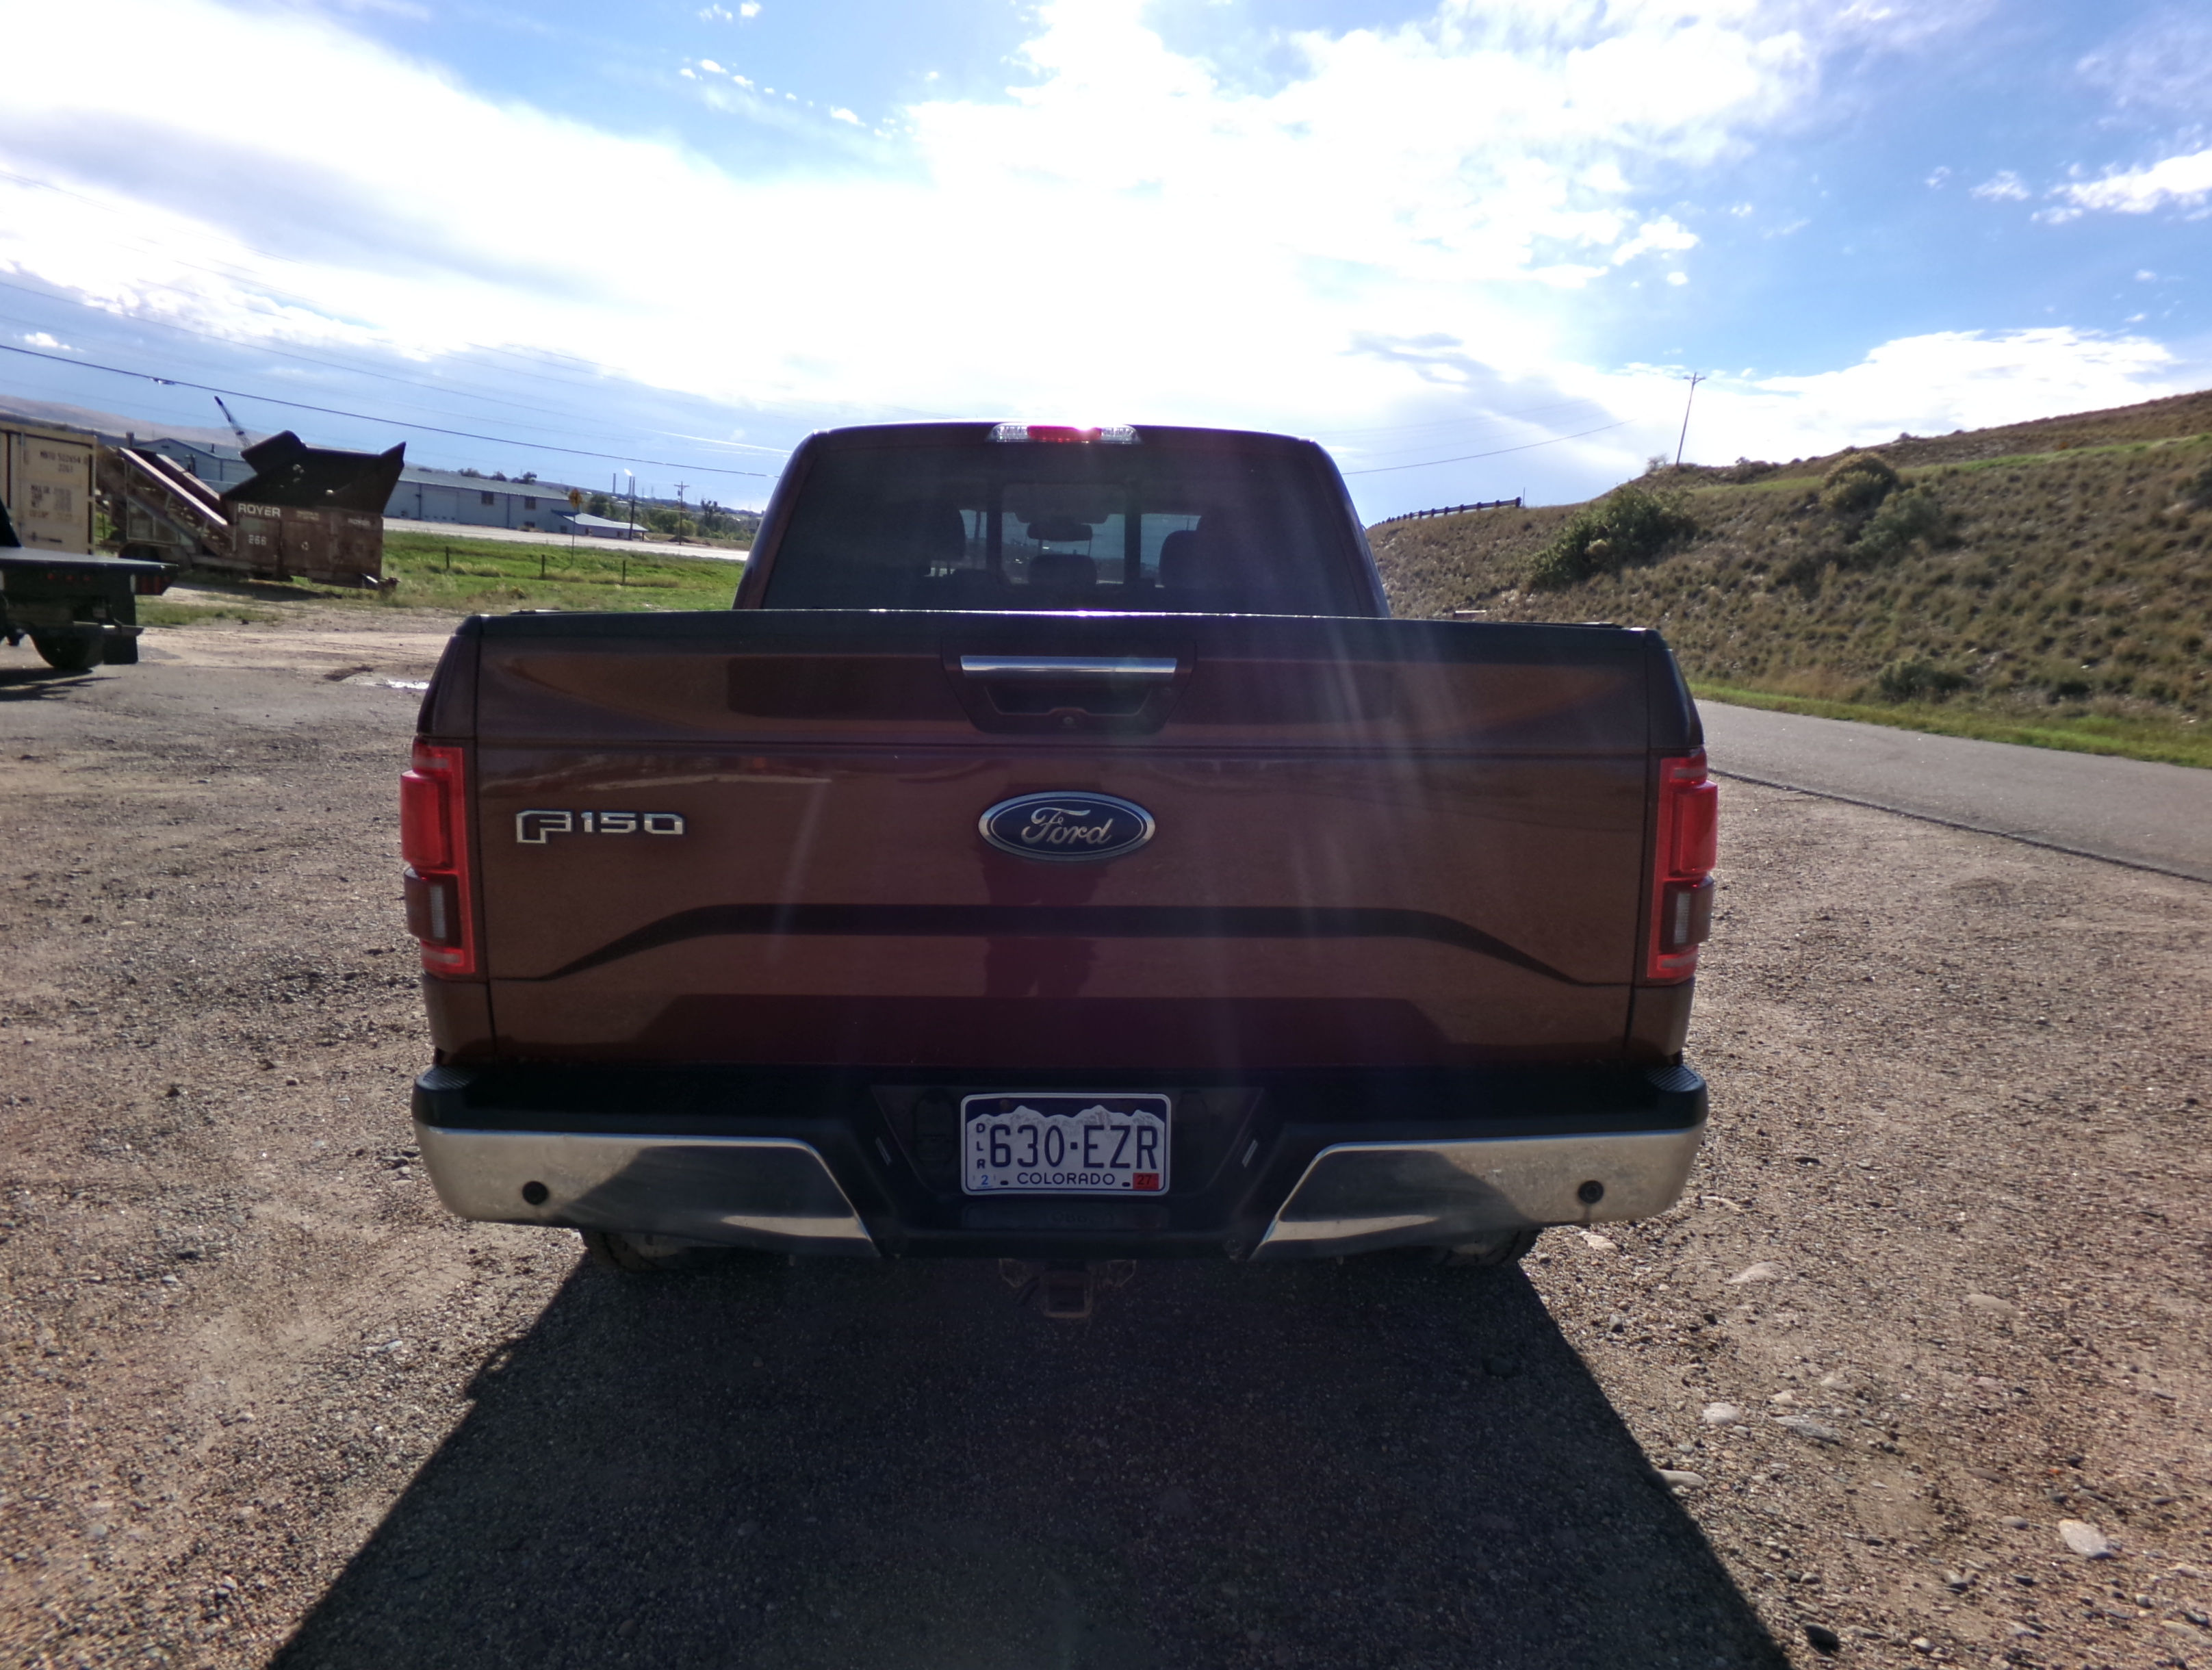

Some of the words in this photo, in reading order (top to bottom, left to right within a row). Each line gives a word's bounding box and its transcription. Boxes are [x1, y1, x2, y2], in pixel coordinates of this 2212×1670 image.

[237, 503, 281, 517] ROYER
[1020, 807, 1111, 844] Ford
[976, 1123, 986, 1169] DLR
[981, 1174, 988, 1185] 2
[1017, 1172, 1116, 1185] COLORADO
[1137, 1174, 1152, 1185] 27
